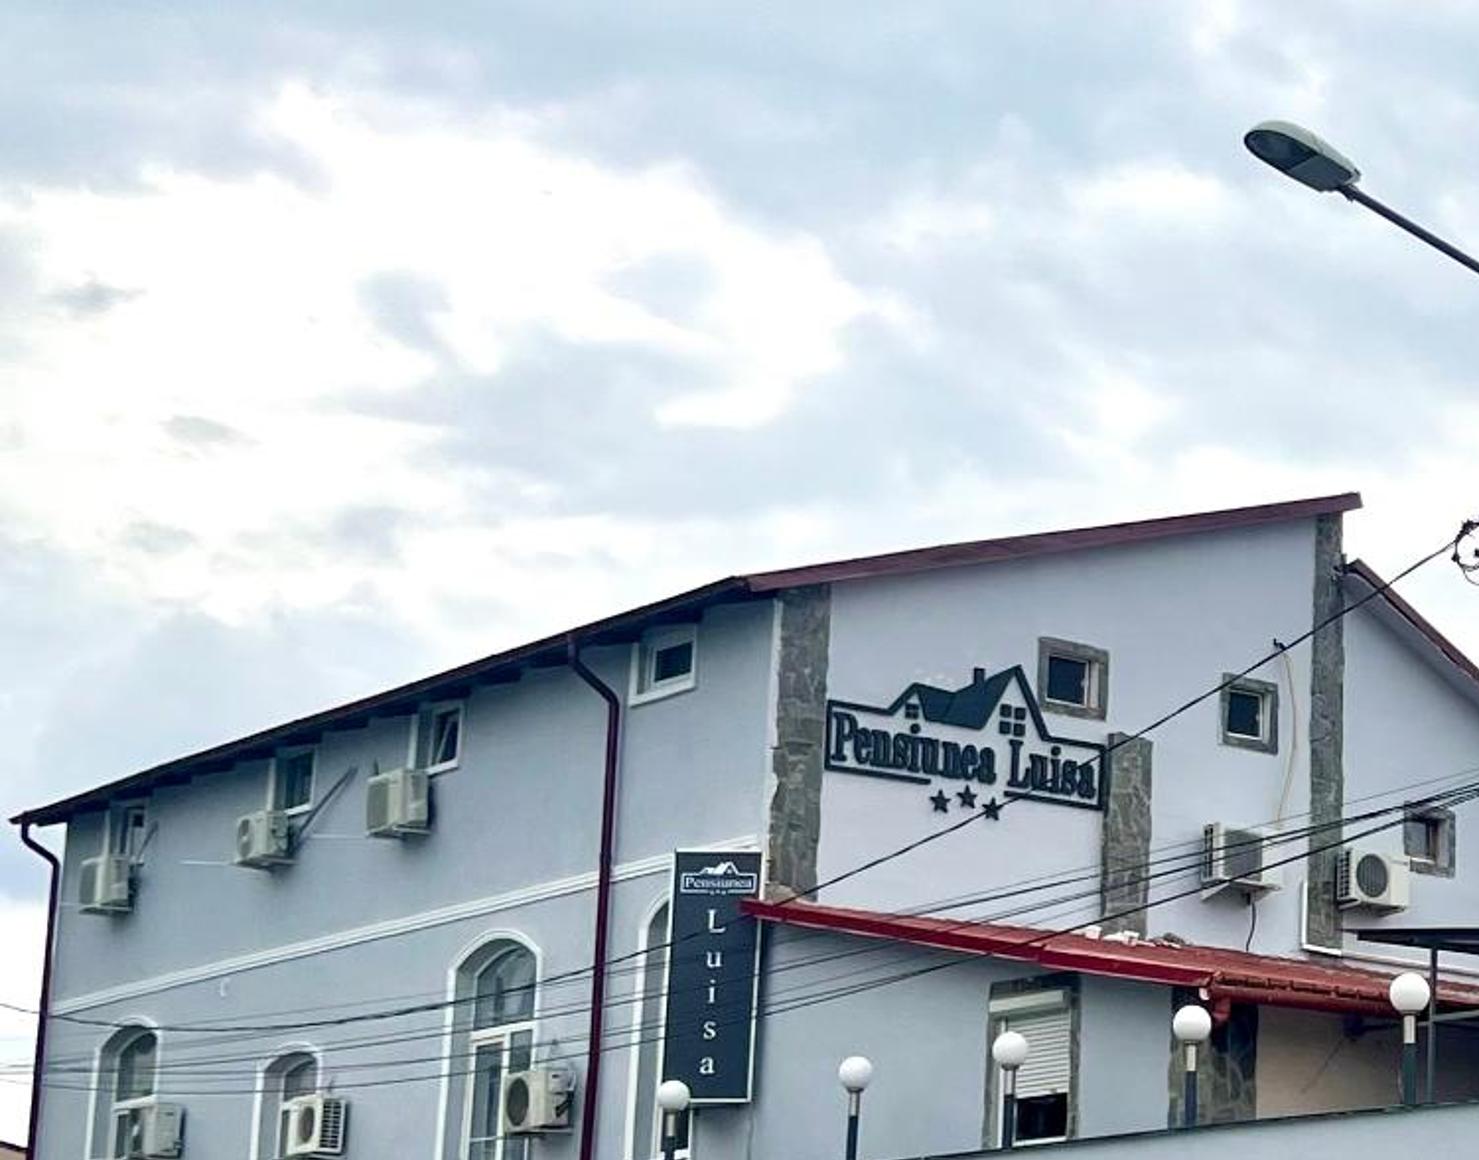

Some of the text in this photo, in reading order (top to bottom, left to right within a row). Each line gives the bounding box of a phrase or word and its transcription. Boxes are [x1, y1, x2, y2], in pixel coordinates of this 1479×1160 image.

[831, 712, 1097, 798] Pensiunea Luisa
[685, 876, 753, 889] Pensiunea
[699, 908, 726, 1075] Luisa
